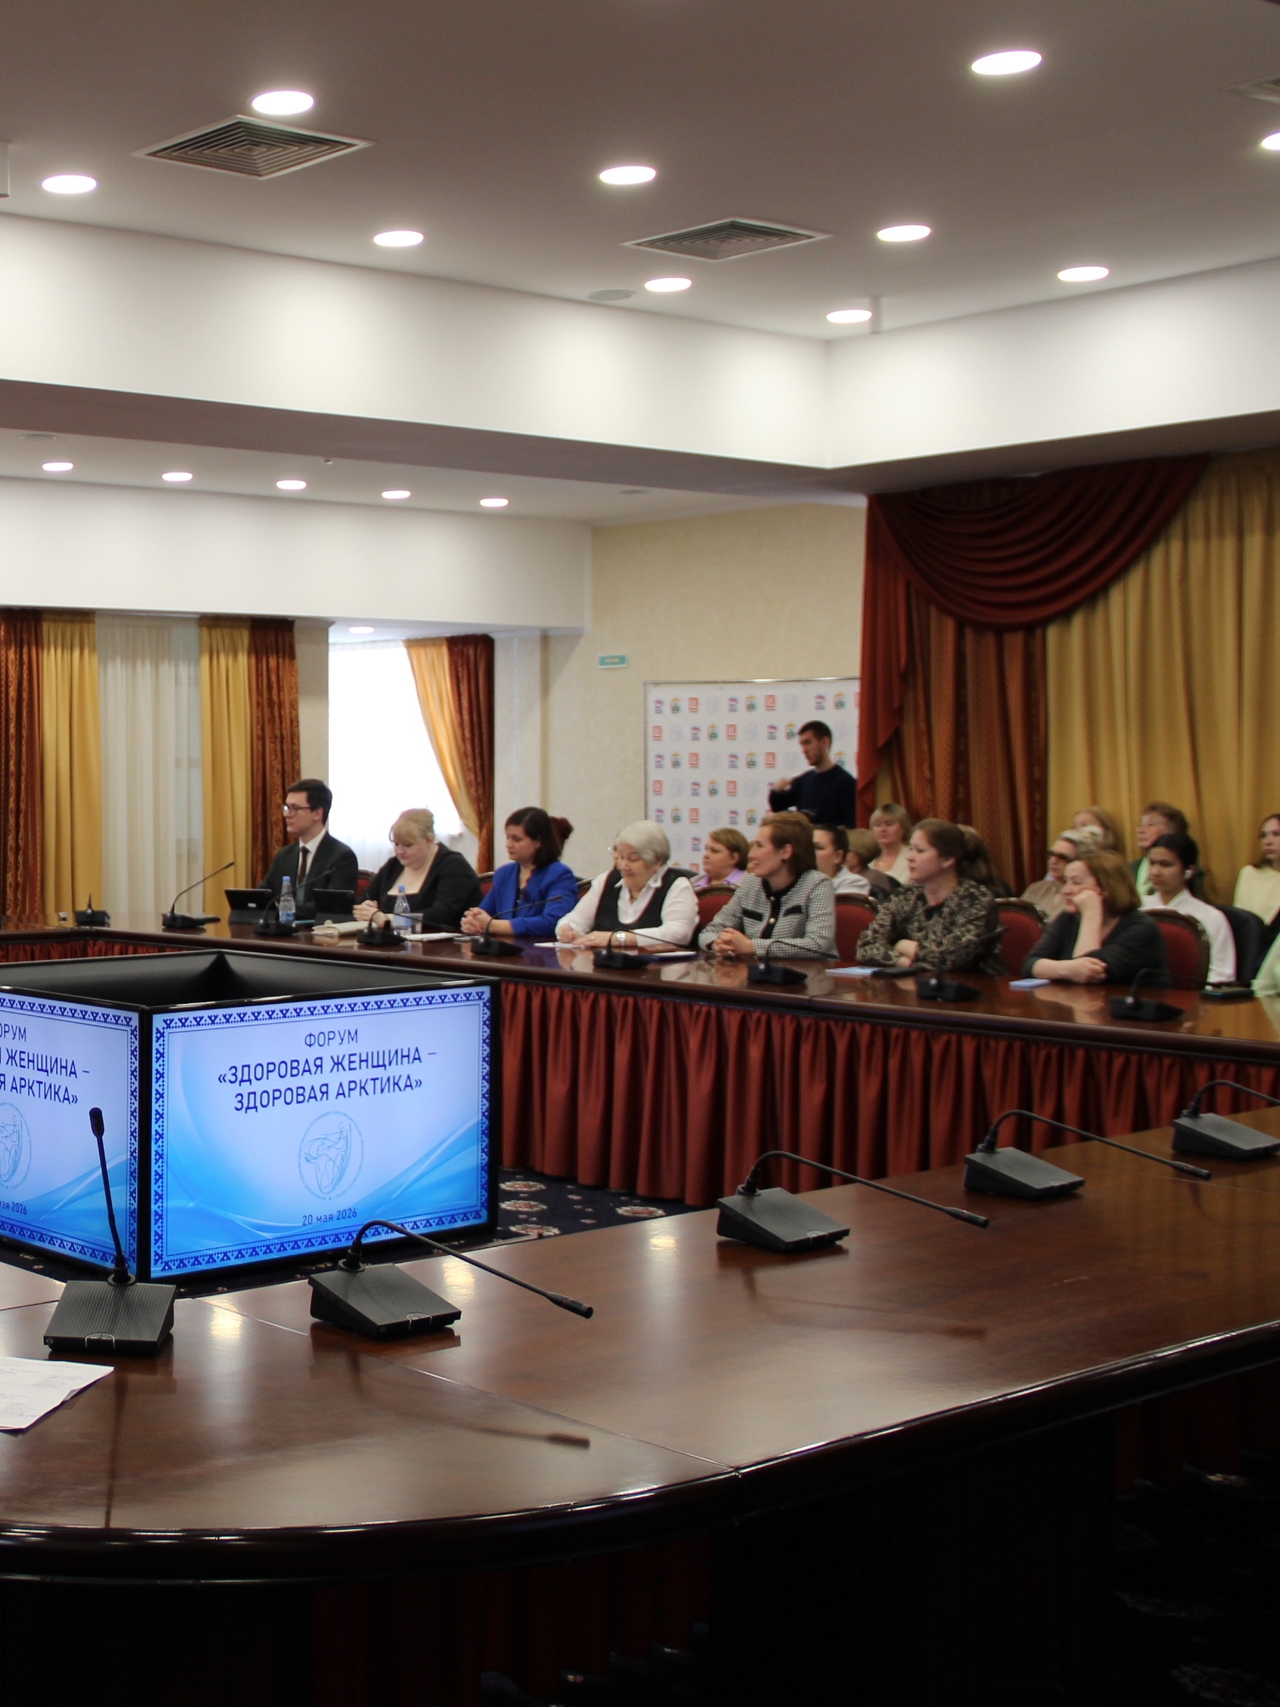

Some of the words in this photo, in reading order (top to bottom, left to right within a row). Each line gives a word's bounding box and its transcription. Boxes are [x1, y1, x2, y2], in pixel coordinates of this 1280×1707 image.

[304, 1028, 358, 1048] ФОРУМ
[5, 1047, 78, 1079] ЖЕНЩИНА
[217, 1056, 324, 1087] «ЗДОРОВАЯ
[329, 1046, 423, 1073] ЖЕНЩИНА
[10, 1075, 79, 1105] АРКТИКА»
[233, 1082, 330, 1114] ЗДОРОВАЯ
[335, 1073, 423, 1099] АРКТИКА»
[11, 1201, 27, 1216] 2026
[302, 1214, 313, 1226] 20
[316, 1213, 334, 1223] мая
[336, 1207, 358, 1221] 2026
